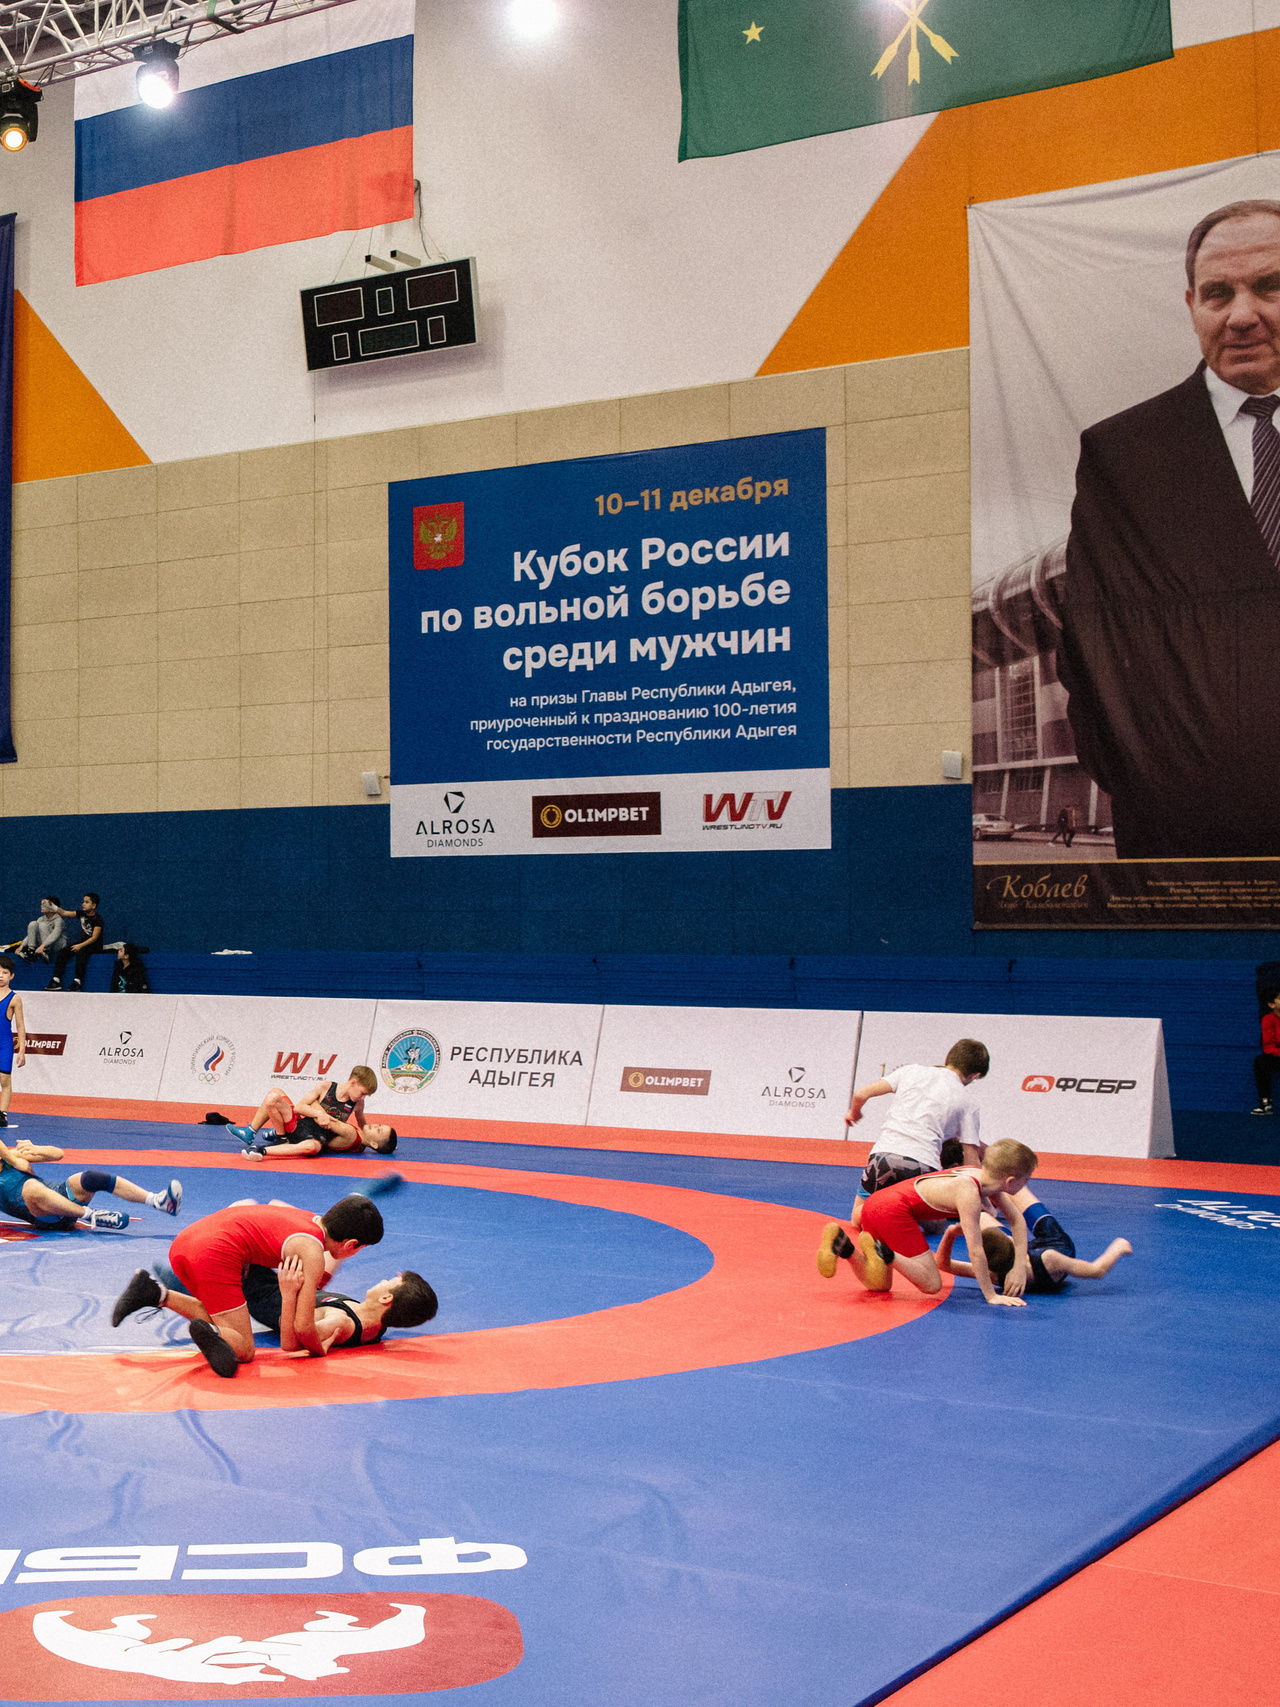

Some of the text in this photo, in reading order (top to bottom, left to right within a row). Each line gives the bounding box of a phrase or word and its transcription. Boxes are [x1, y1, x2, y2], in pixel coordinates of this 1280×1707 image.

[669, 476, 789, 512] декабря
[513, 531, 790, 590] Кубок России
[421, 572, 791, 634] по вольной борьбе
[502, 626, 791, 678] среди мужчин
[510, 680, 797, 710] на призы Главы Республики Адыгея,
[470, 700, 797, 732] приуроченный к празднованию 100-летия
[486, 723, 797, 752] государственности Республики Адыгея
[564, 806, 649, 823] OLIMPBET
[415, 819, 495, 835] ALROSA
[427, 837, 484, 848] DIAMONDS
[986, 873, 1088, 898] Коблев
[99, 1047, 144, 1058] ALROSA
[103, 1058, 136, 1066] DIAMONDS
[450, 1046, 583, 1066] РЕСПУБЛИКА
[468, 1069, 555, 1088] АДЫГЕЯ
[645, 1075, 704, 1088] OLIMPBET
[1055, 1077, 1137, 1094] ФСБР
[761, 1086, 826, 1099] ALROSA
[768, 1100, 816, 1109] DIAMONDS
